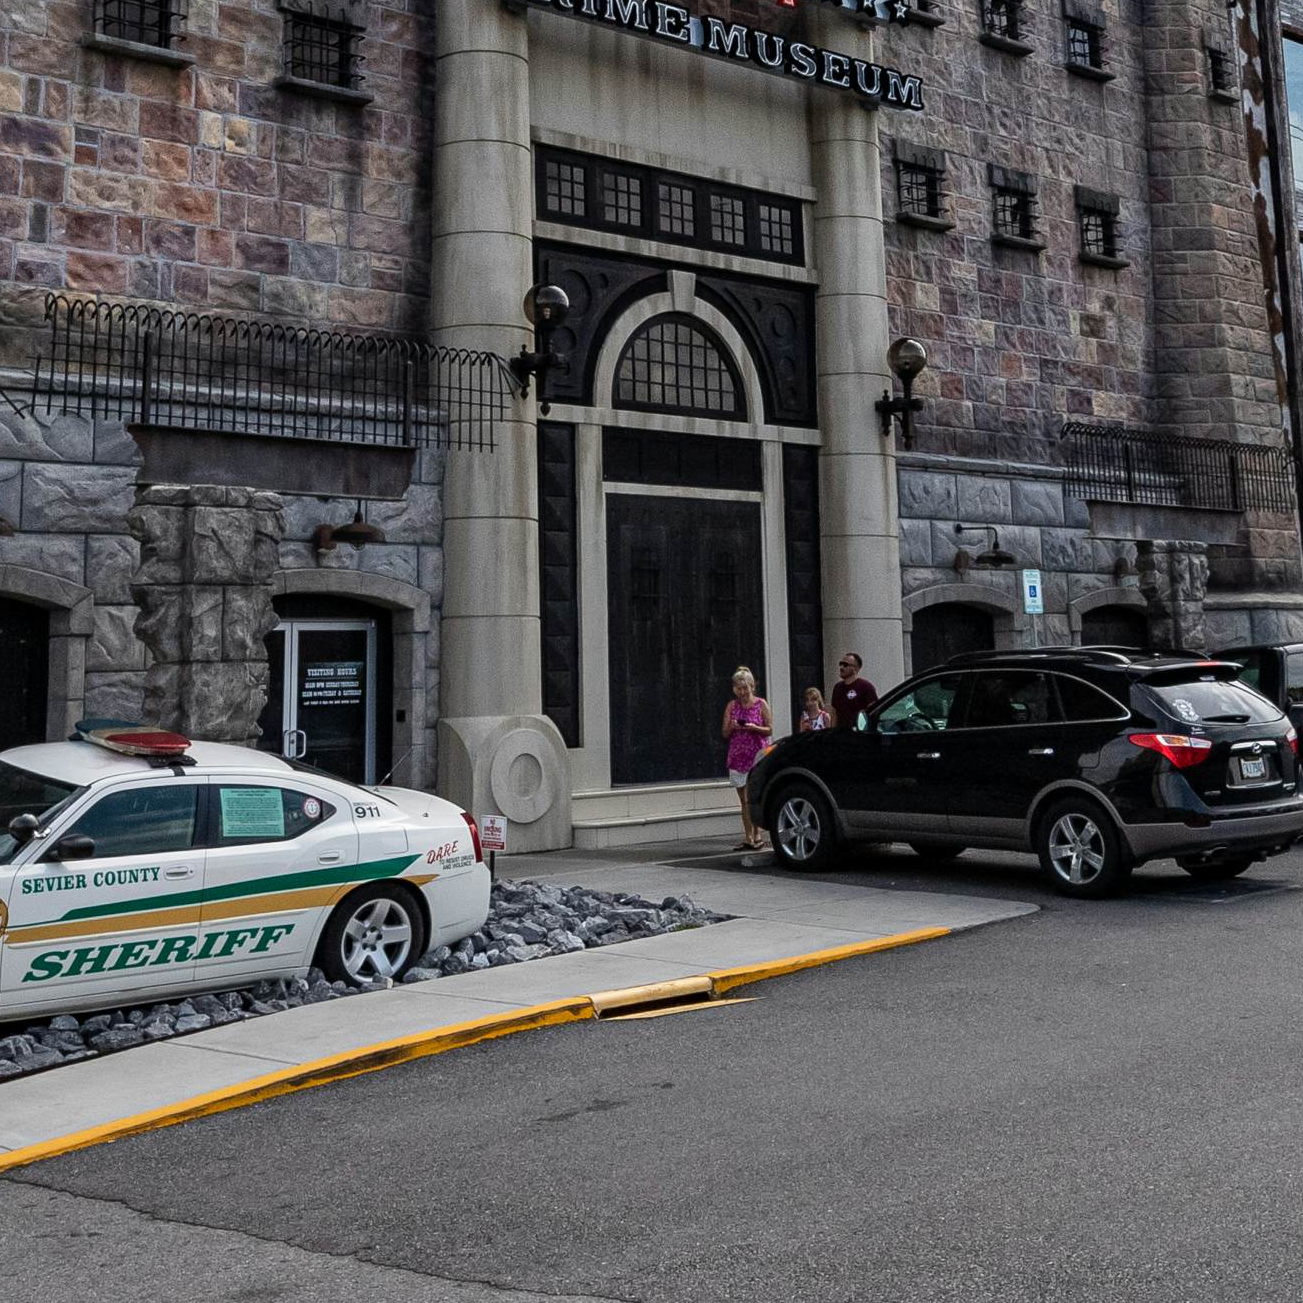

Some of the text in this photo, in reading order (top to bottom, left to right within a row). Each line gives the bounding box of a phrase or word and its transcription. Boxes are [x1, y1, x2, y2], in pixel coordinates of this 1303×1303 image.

[705, 14, 924, 111] MUSEUM
[355, 806, 380, 818] 911
[22, 867, 161, 894] SEVIER COUNTY
[21, 924, 295, 983] SHERIFF
